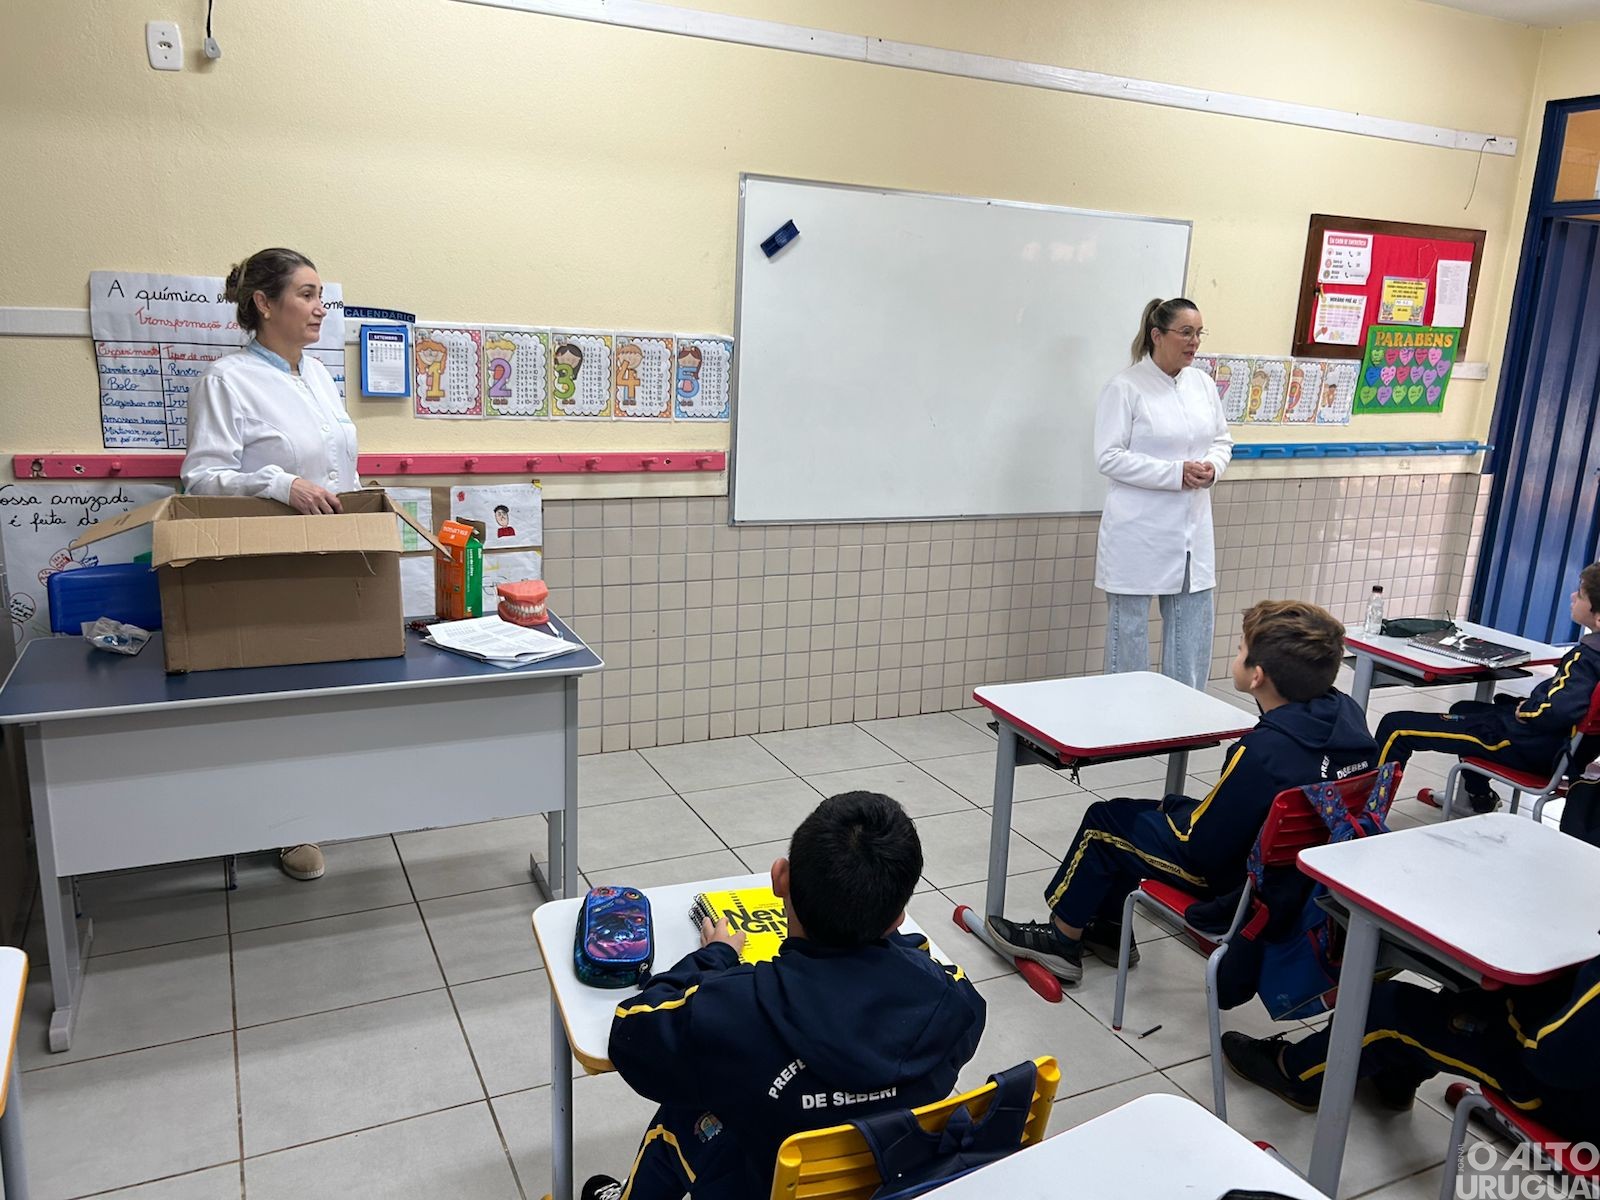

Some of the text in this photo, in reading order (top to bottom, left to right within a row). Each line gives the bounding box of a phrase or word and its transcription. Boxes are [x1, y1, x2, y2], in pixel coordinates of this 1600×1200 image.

[108, 279, 124, 298] A
[135, 286, 210, 310] química
[135, 306, 222, 332] Transformação
[107, 377, 140, 390] Bolo
[426, 360, 446, 398] 1
[488, 358, 512, 397] 2
[553, 363, 576, 399] 3
[616, 360, 640, 398] 4
[677, 367, 700, 398] 5
[51, 488, 134, 512] amizade
[30, 509, 66, 532] feita
[77, 508, 99, 526] de
[722, 908, 788, 930] Nev
[802, 1093, 827, 1109] DE
